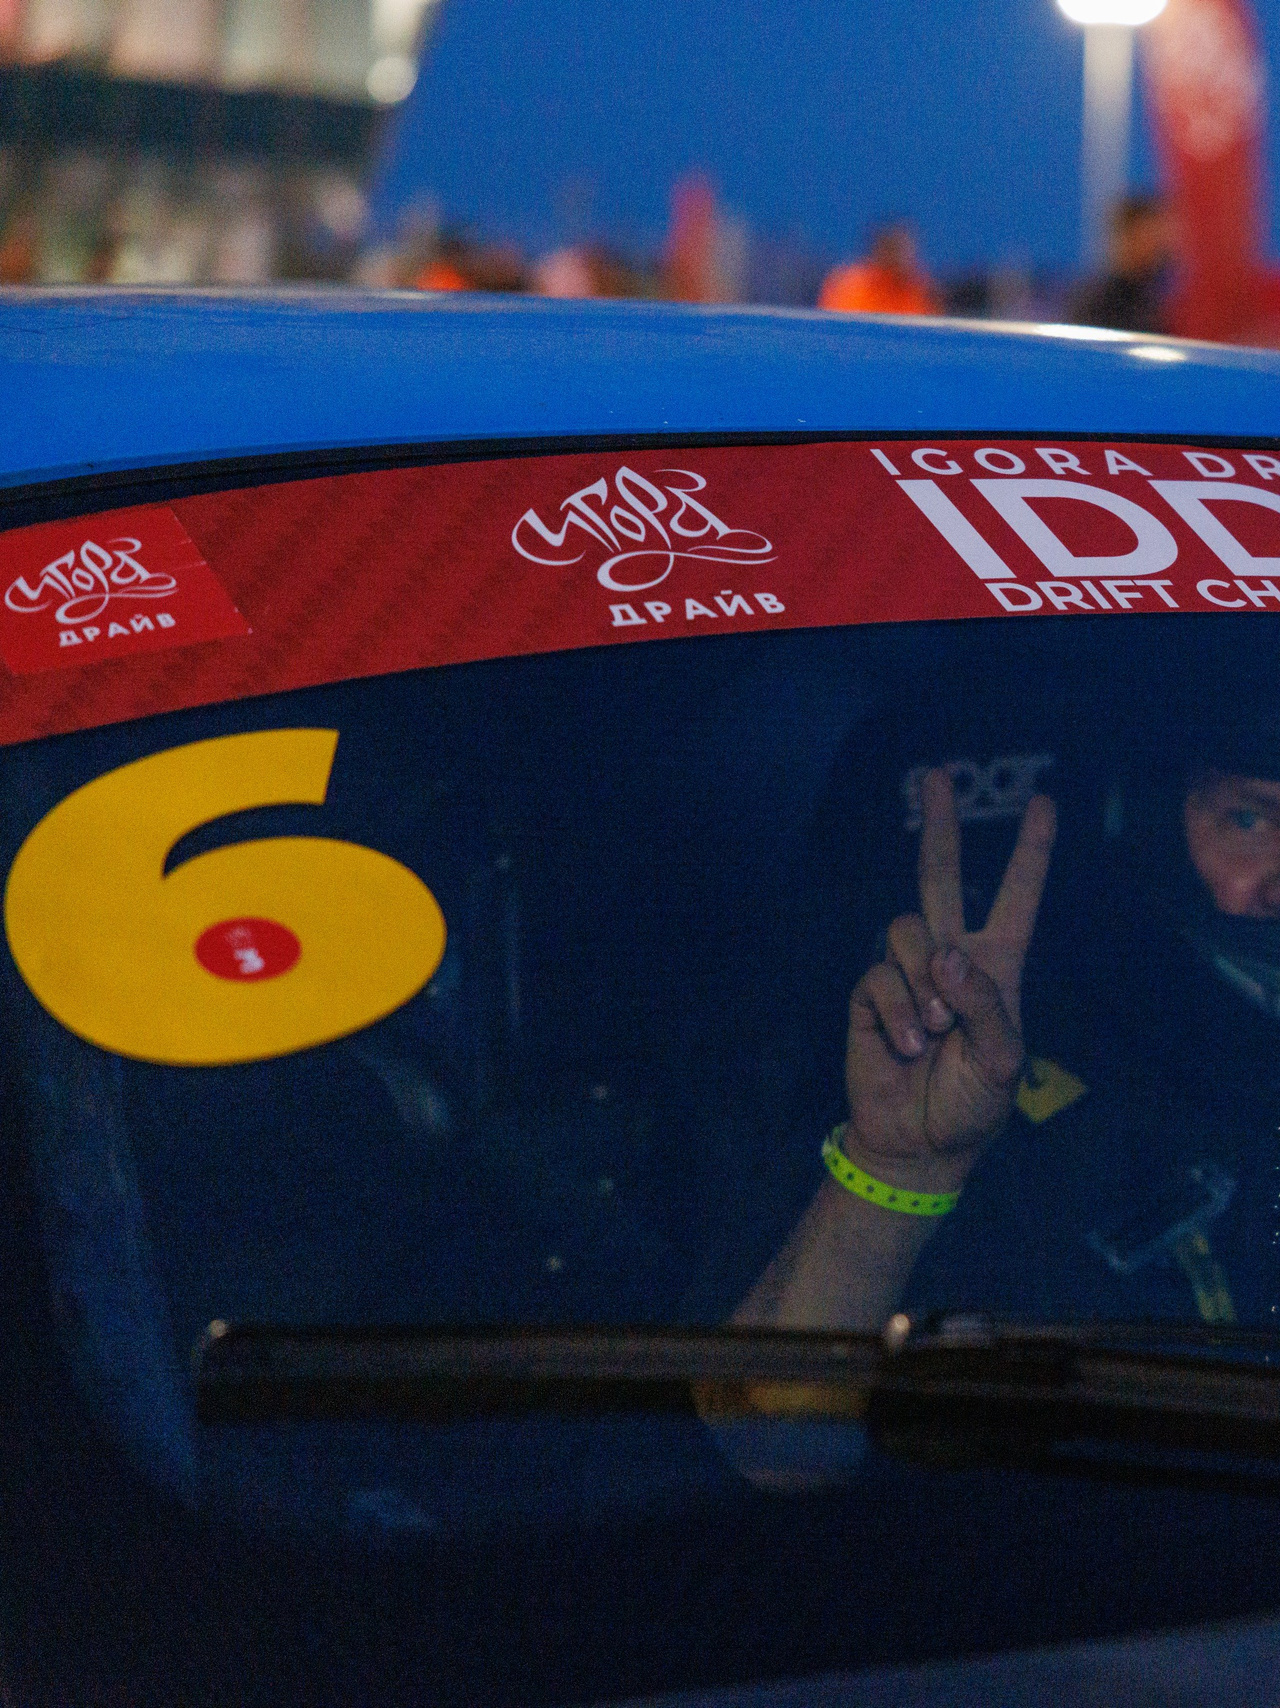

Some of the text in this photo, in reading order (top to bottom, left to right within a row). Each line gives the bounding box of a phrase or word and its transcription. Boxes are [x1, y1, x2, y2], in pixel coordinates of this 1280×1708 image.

[869, 447, 1153, 478] IGORA
[608, 588, 787, 628] ДРАЙВ
[984, 578, 1180, 613] DRIFT
[57, 611, 178, 648] ДРАЙВ
[3, 727, 447, 1068] 6
